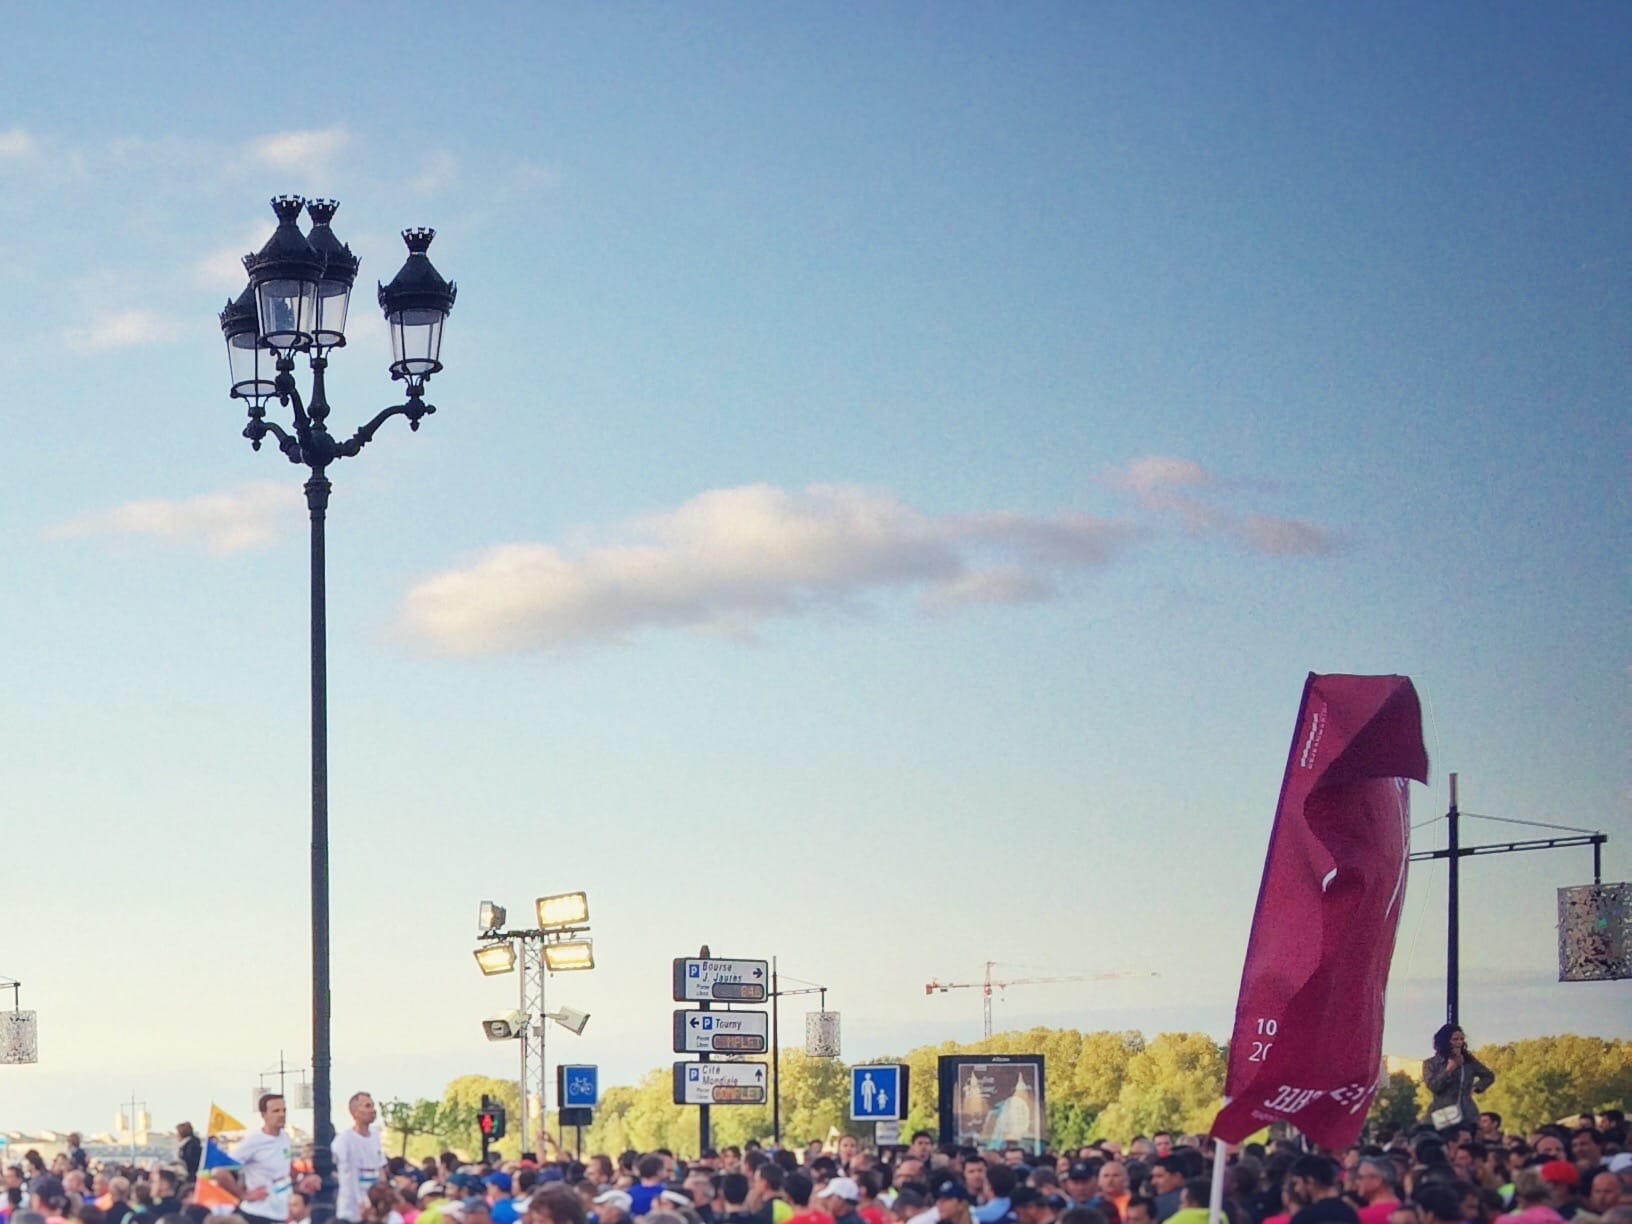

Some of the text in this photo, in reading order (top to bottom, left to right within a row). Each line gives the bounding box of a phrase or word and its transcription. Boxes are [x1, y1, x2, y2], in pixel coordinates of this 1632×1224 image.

[702, 961, 732, 971] Bourse
[715, 1018, 742, 1031] Tourny
[1257, 1018, 1277, 1036] 10
